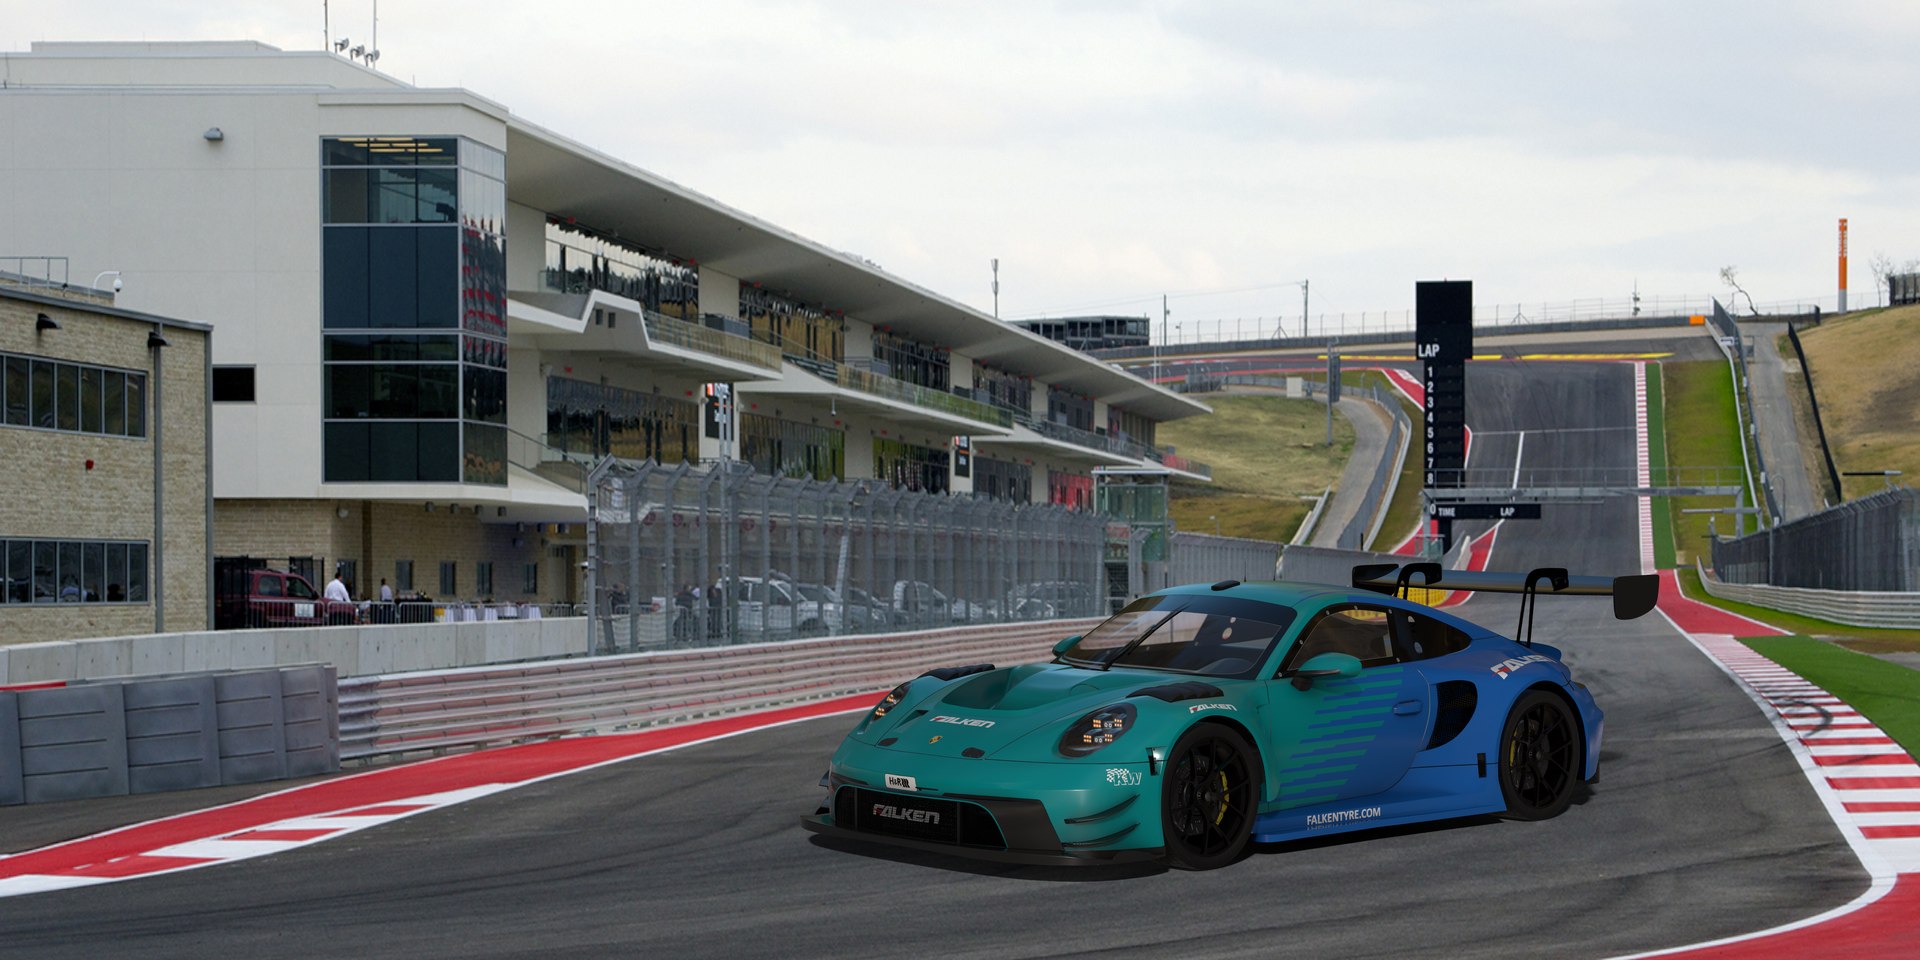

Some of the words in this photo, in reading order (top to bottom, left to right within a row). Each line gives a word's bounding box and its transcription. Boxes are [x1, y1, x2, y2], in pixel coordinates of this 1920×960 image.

[1418, 344, 1440, 357] LAP
[1428, 366, 1433, 378] 1
[1427, 381, 1434, 393] 2
[1427, 396, 1434, 408] 3
[1427, 411, 1434, 423] 4
[1427, 426, 1434, 439] 5
[1427, 441, 1434, 454] 6
[1427, 457, 1434, 469] 7
[1427, 472, 1434, 485] 8
[1438, 507, 1456, 517] TIME
[1500, 507, 1515, 517] LAP
[1189, 703, 1237, 714] FALKEN
[929, 715, 995, 728] FALKEN
[1109, 769, 1142, 786] KW
[873, 803, 940, 825] FALKEN
[1306, 806, 1381, 826] FALKENTYRE.COM
